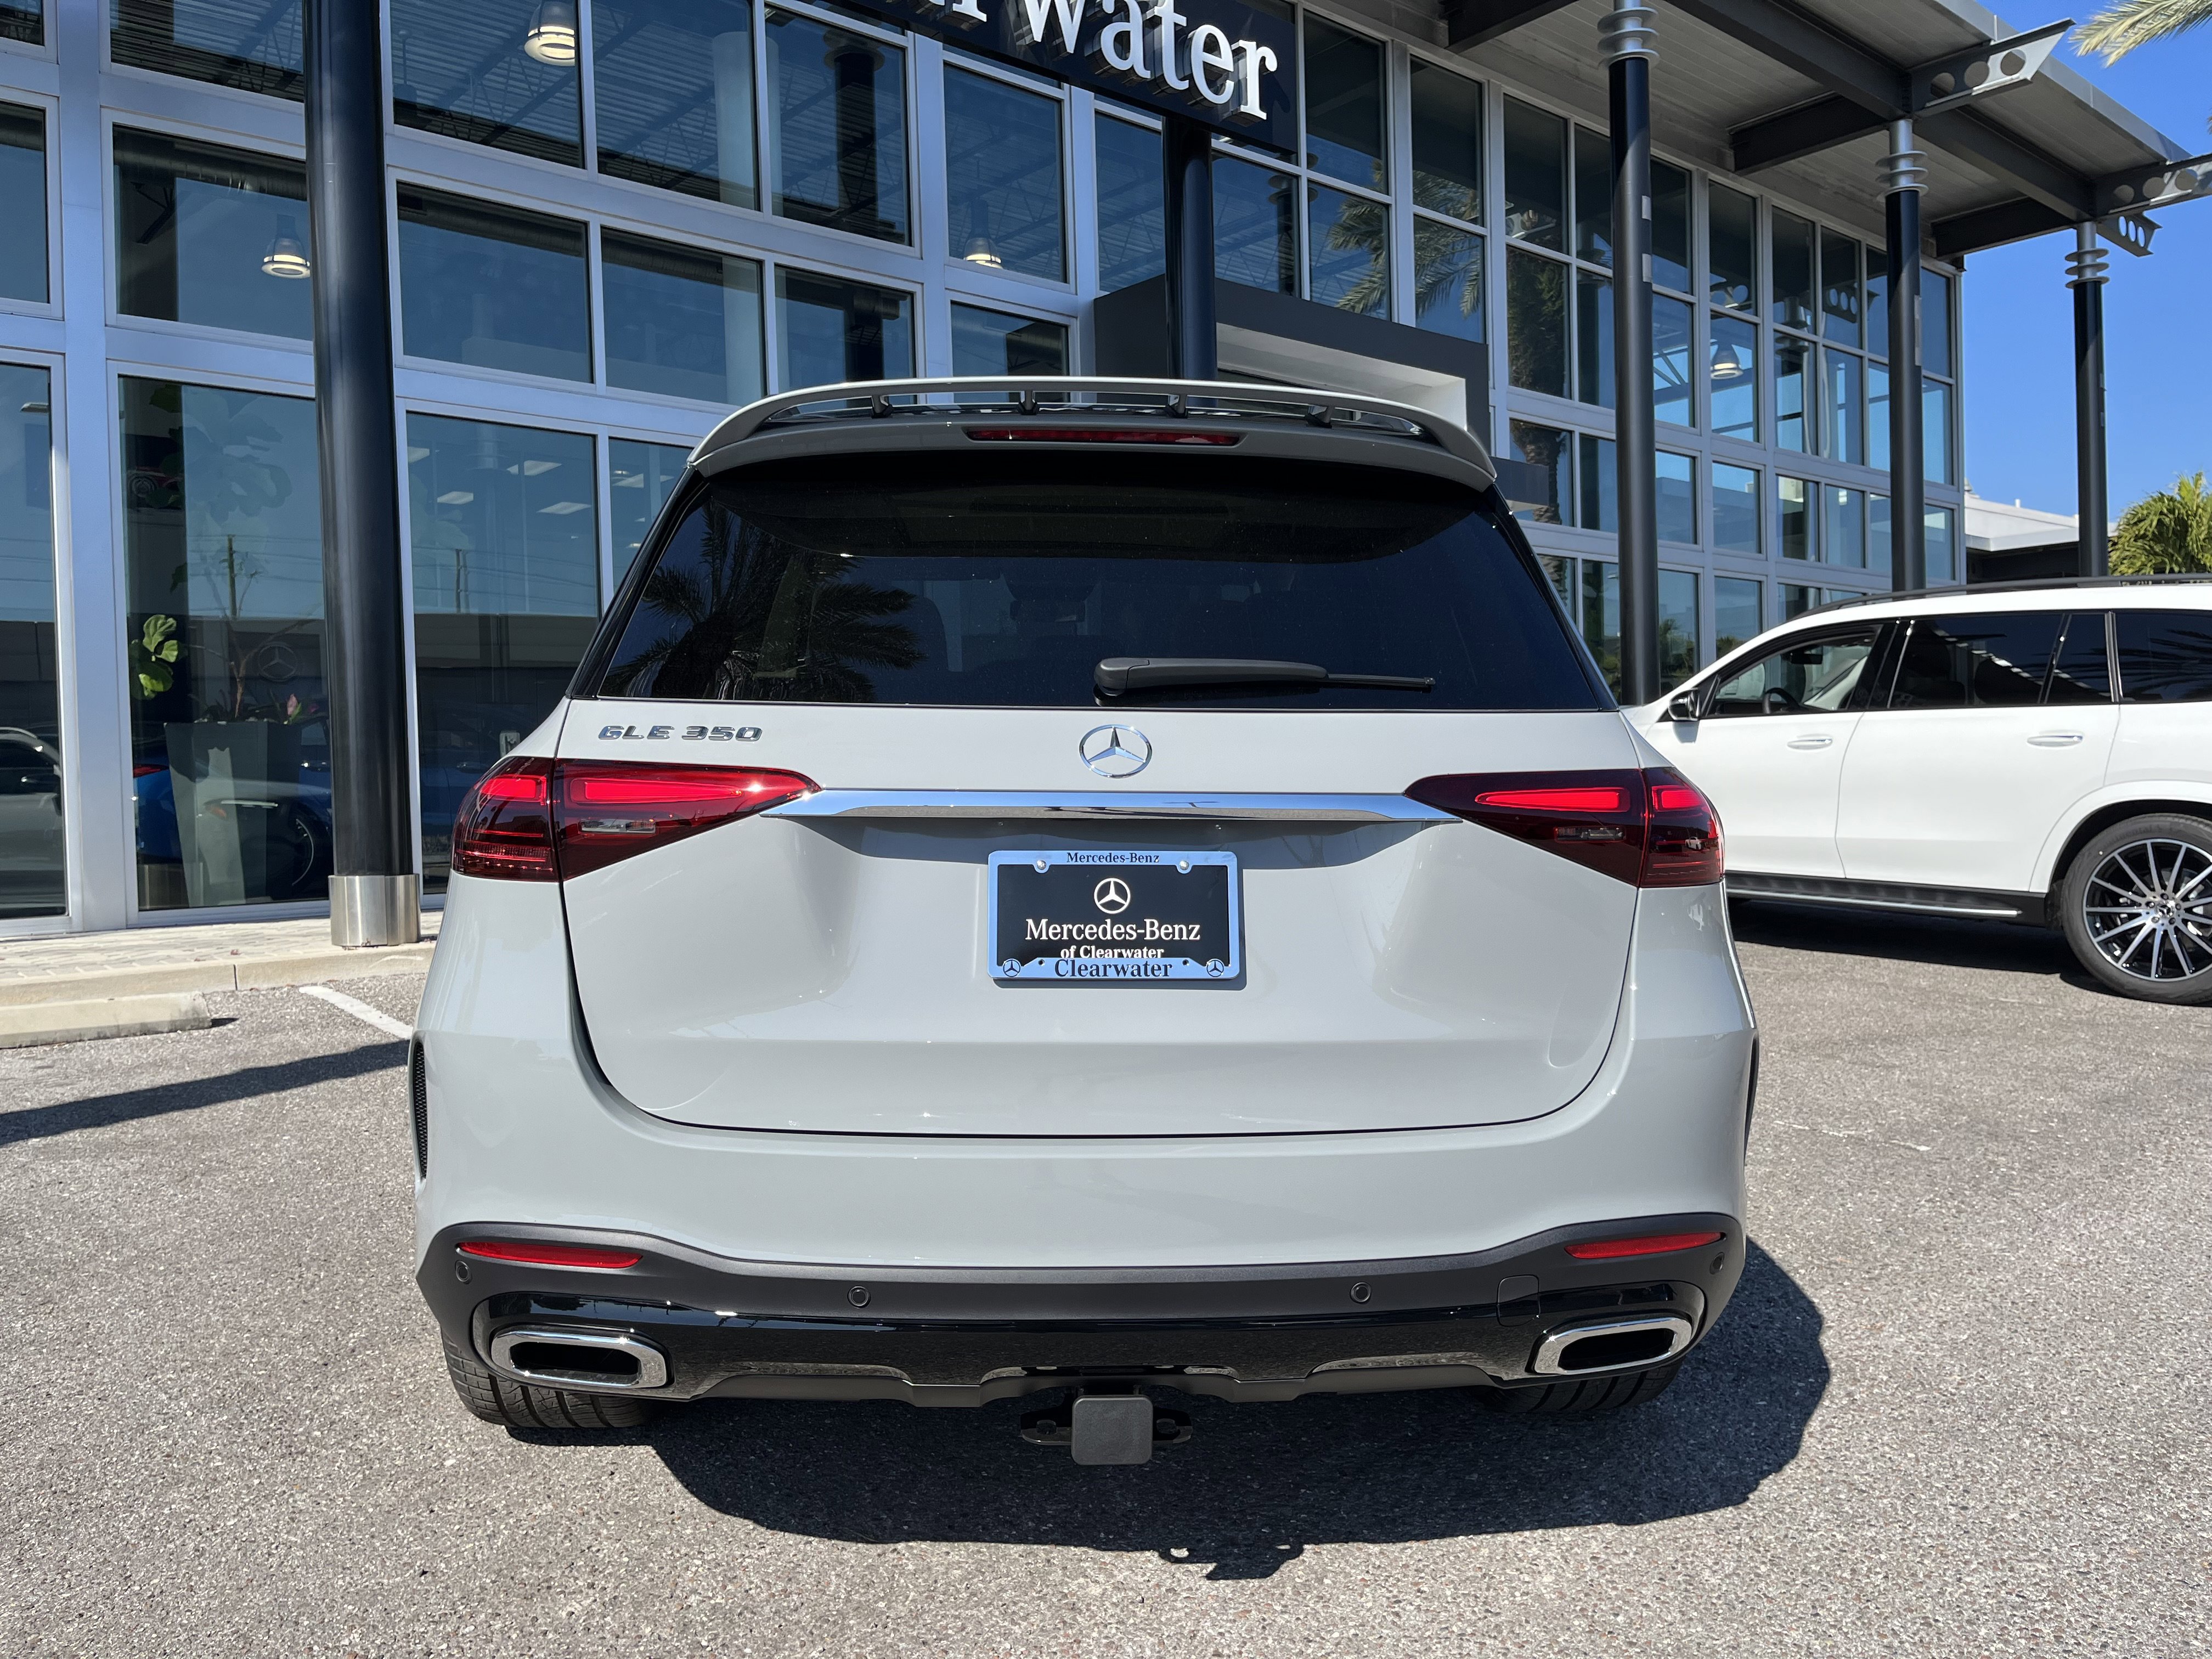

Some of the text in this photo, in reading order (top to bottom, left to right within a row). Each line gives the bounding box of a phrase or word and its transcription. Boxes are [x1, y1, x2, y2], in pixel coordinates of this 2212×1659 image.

[929, 0, 1278, 120] water
[598, 725, 763, 741] GLE 350
[1066, 852, 1160, 863] Mercedes-Benz
[1025, 918, 1201, 941] Mercedes-Benz
[1060, 945, 1164, 959] of Clearwater
[1054, 959, 1173, 978] Clearwater
